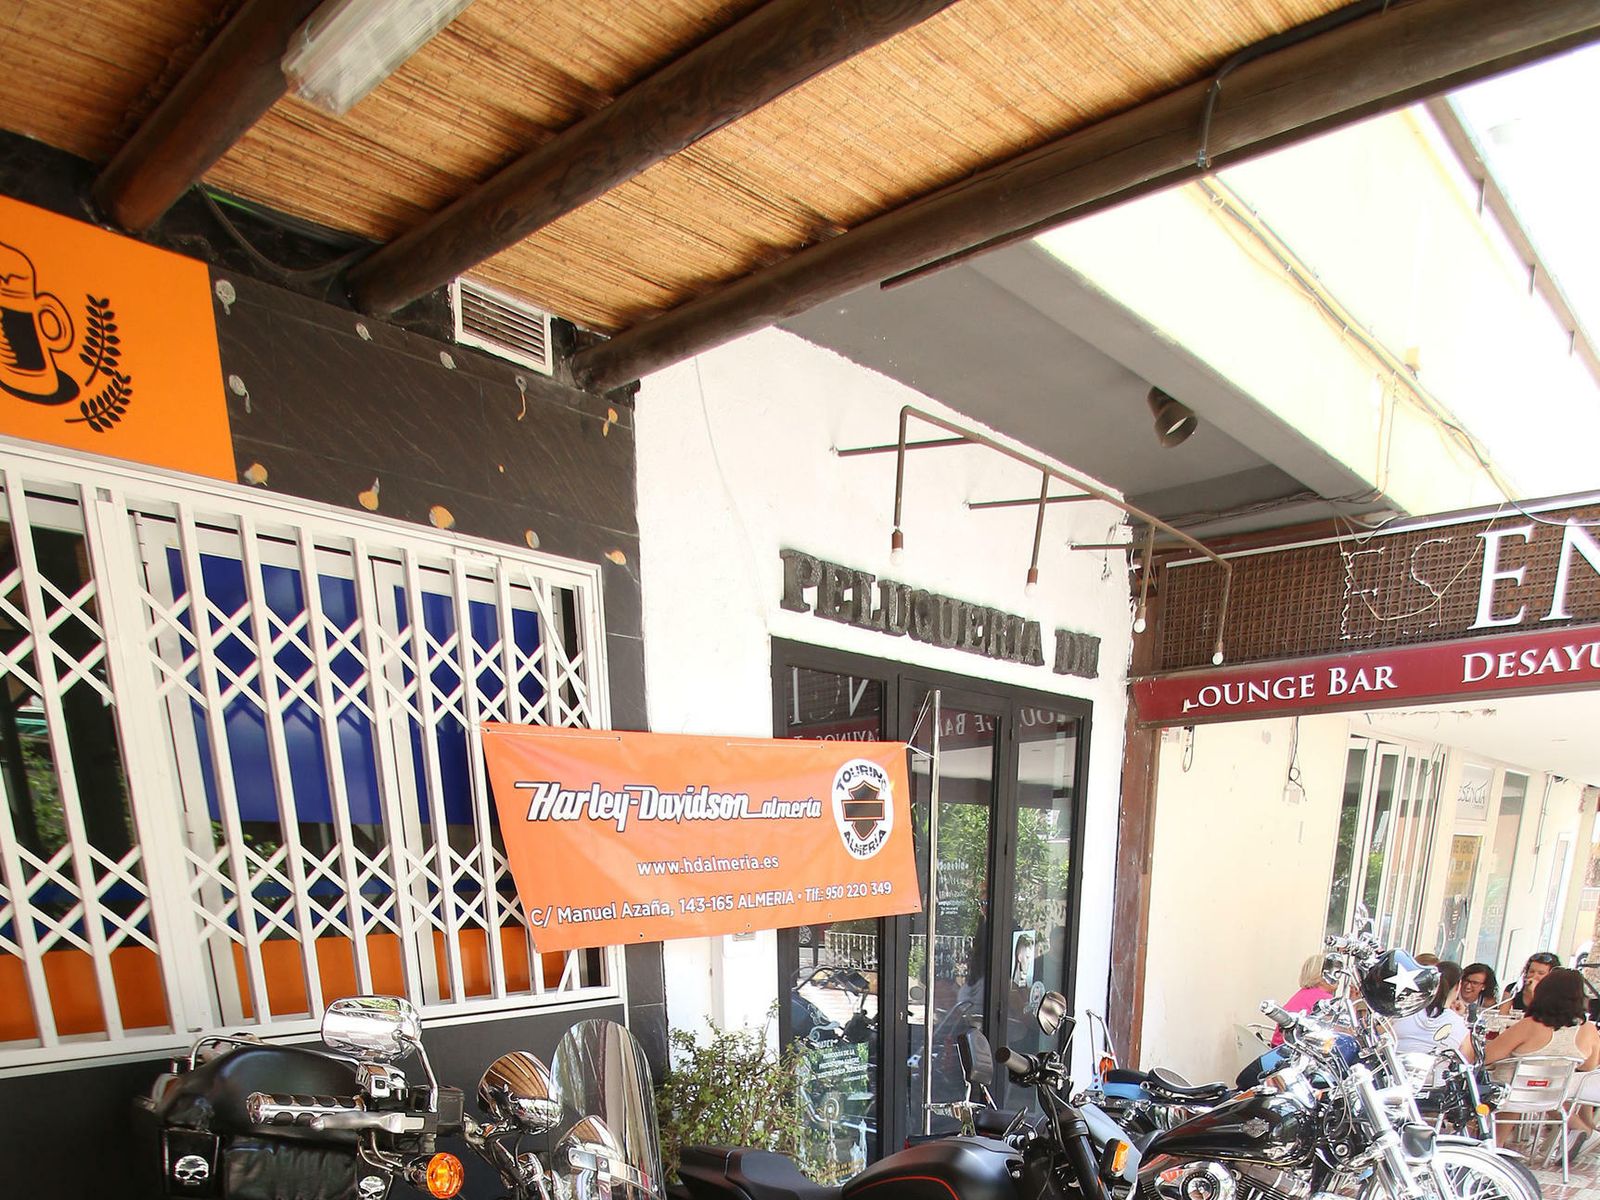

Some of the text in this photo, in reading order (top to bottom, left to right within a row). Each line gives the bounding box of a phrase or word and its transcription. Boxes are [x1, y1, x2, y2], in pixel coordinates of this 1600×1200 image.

[779, 549, 1044, 666] PELUQUERIA
[1327, 665, 1398, 696] BAR
[514, 782, 751, 832] Harley-Davidson
[637, 856, 779, 876] www.hdalmeria.es
[531, 907, 552, 928] C/
[557, 903, 616, 924] Manuel
[621, 900, 674, 918] Azaña,
[679, 895, 733, 914] 143-165
[738, 890, 795, 908] ALMERIA
[826, 886, 844, 900] 950
[847, 883, 867, 898] 220
[871, 881, 892, 895] 349
